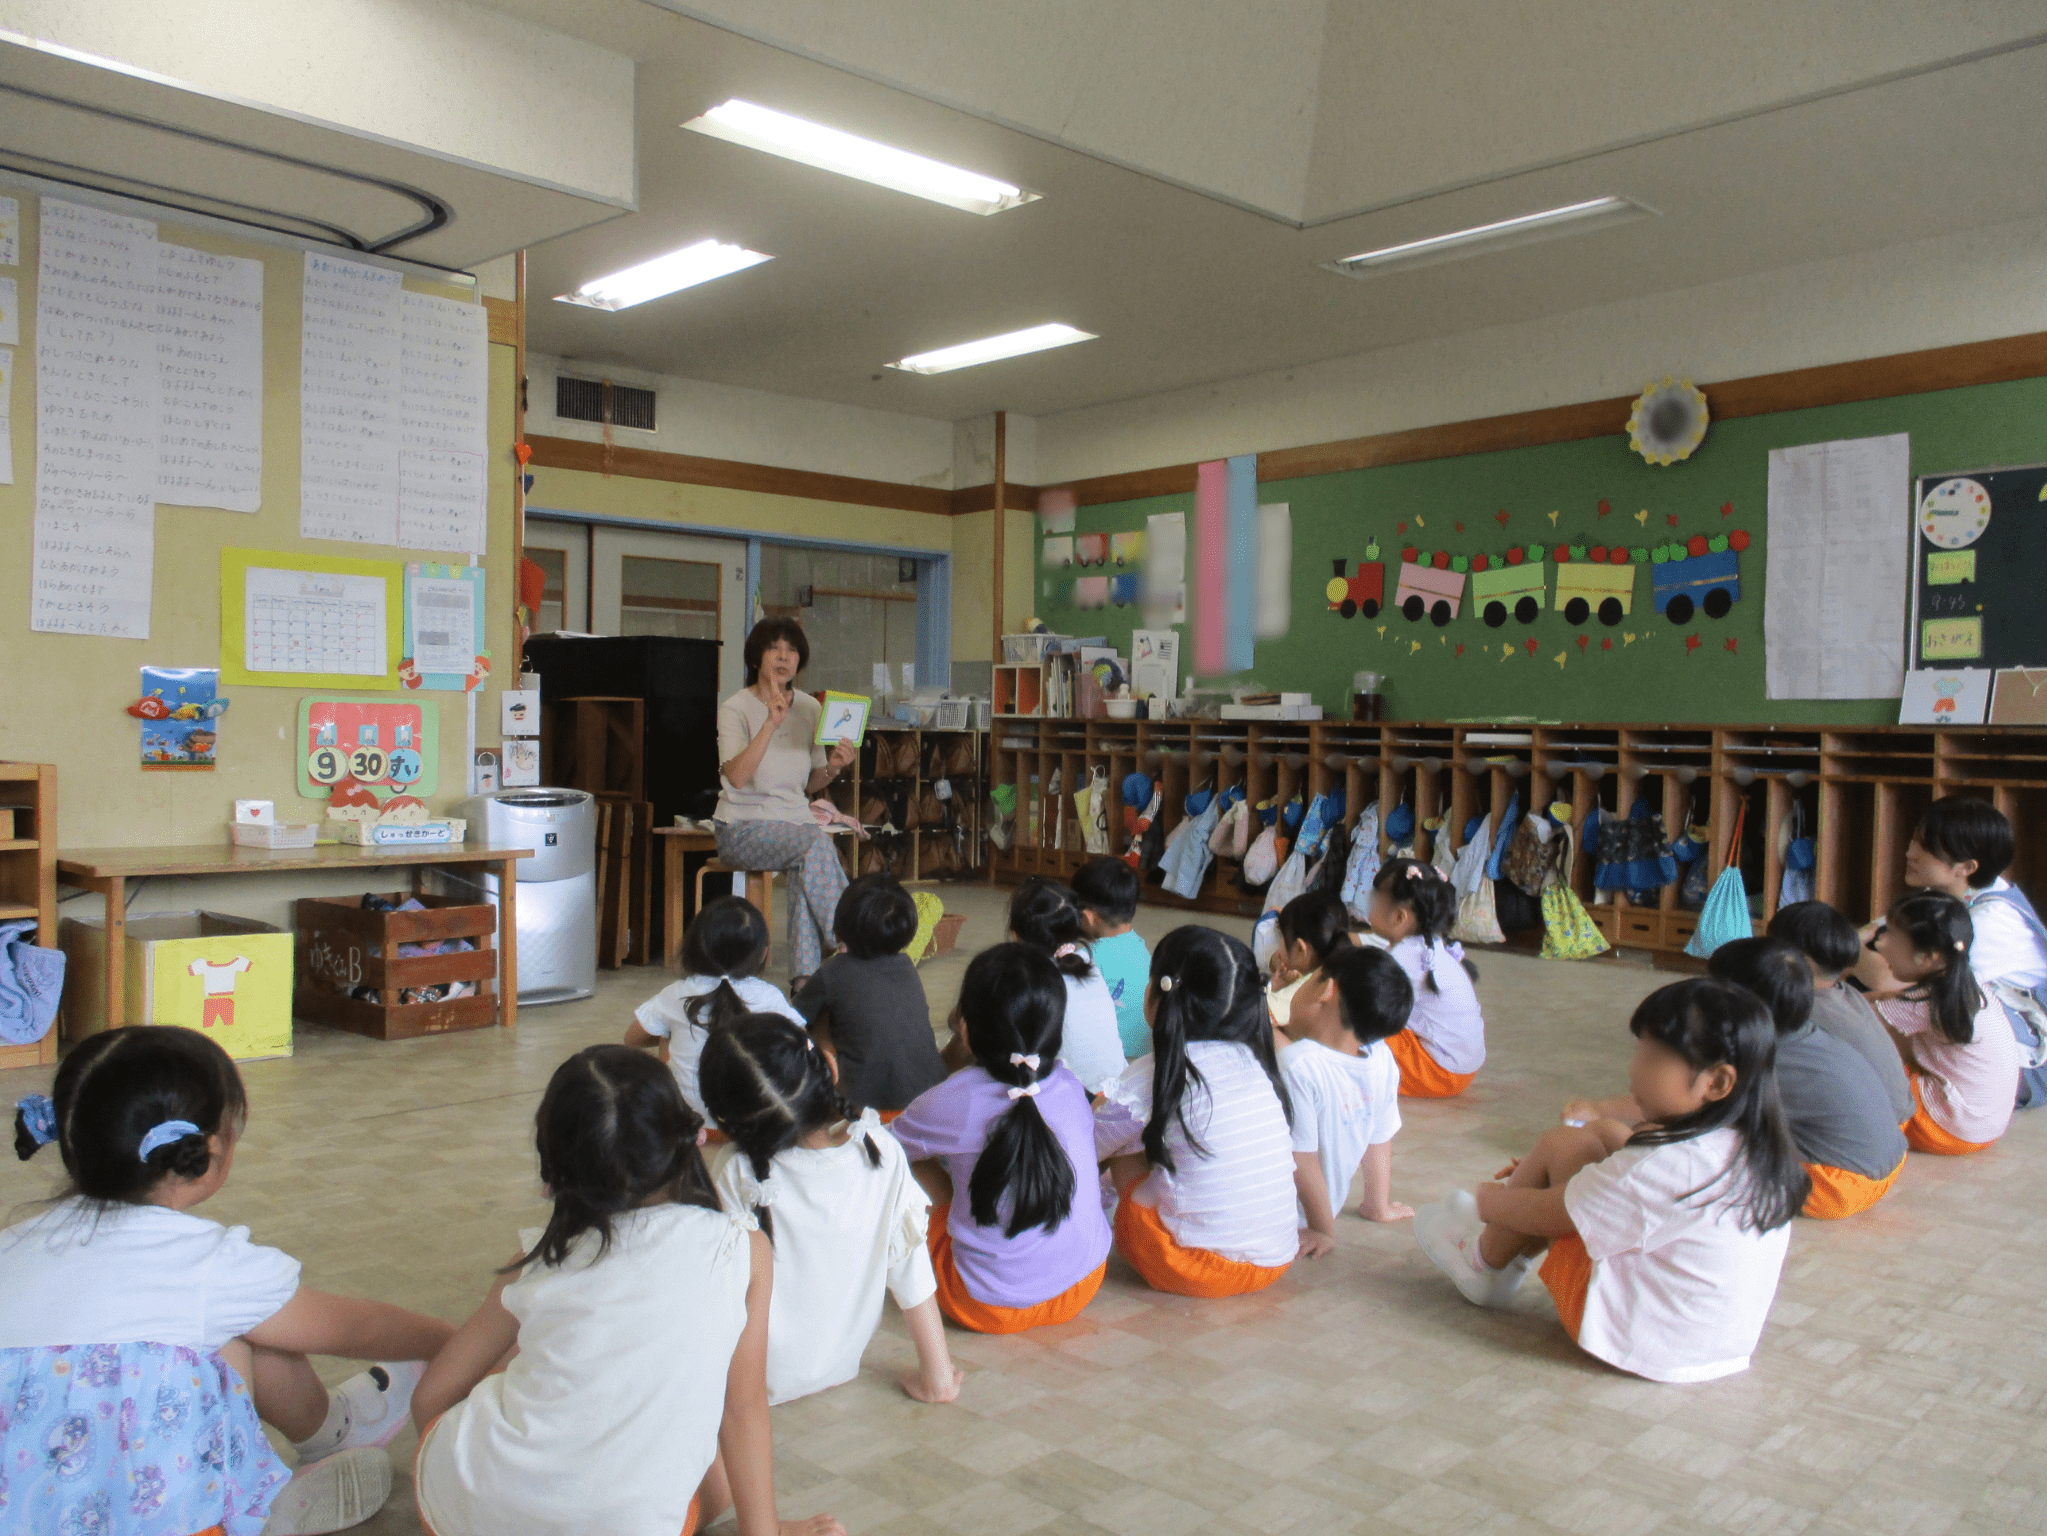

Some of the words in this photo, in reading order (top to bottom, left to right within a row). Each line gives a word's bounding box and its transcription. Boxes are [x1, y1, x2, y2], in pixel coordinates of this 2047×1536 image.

[317, 752, 337, 780] 9
[354, 752, 383, 777] 30
[390, 755, 420, 778] すい
[381, 829, 446, 839] しゅっせきかーど
